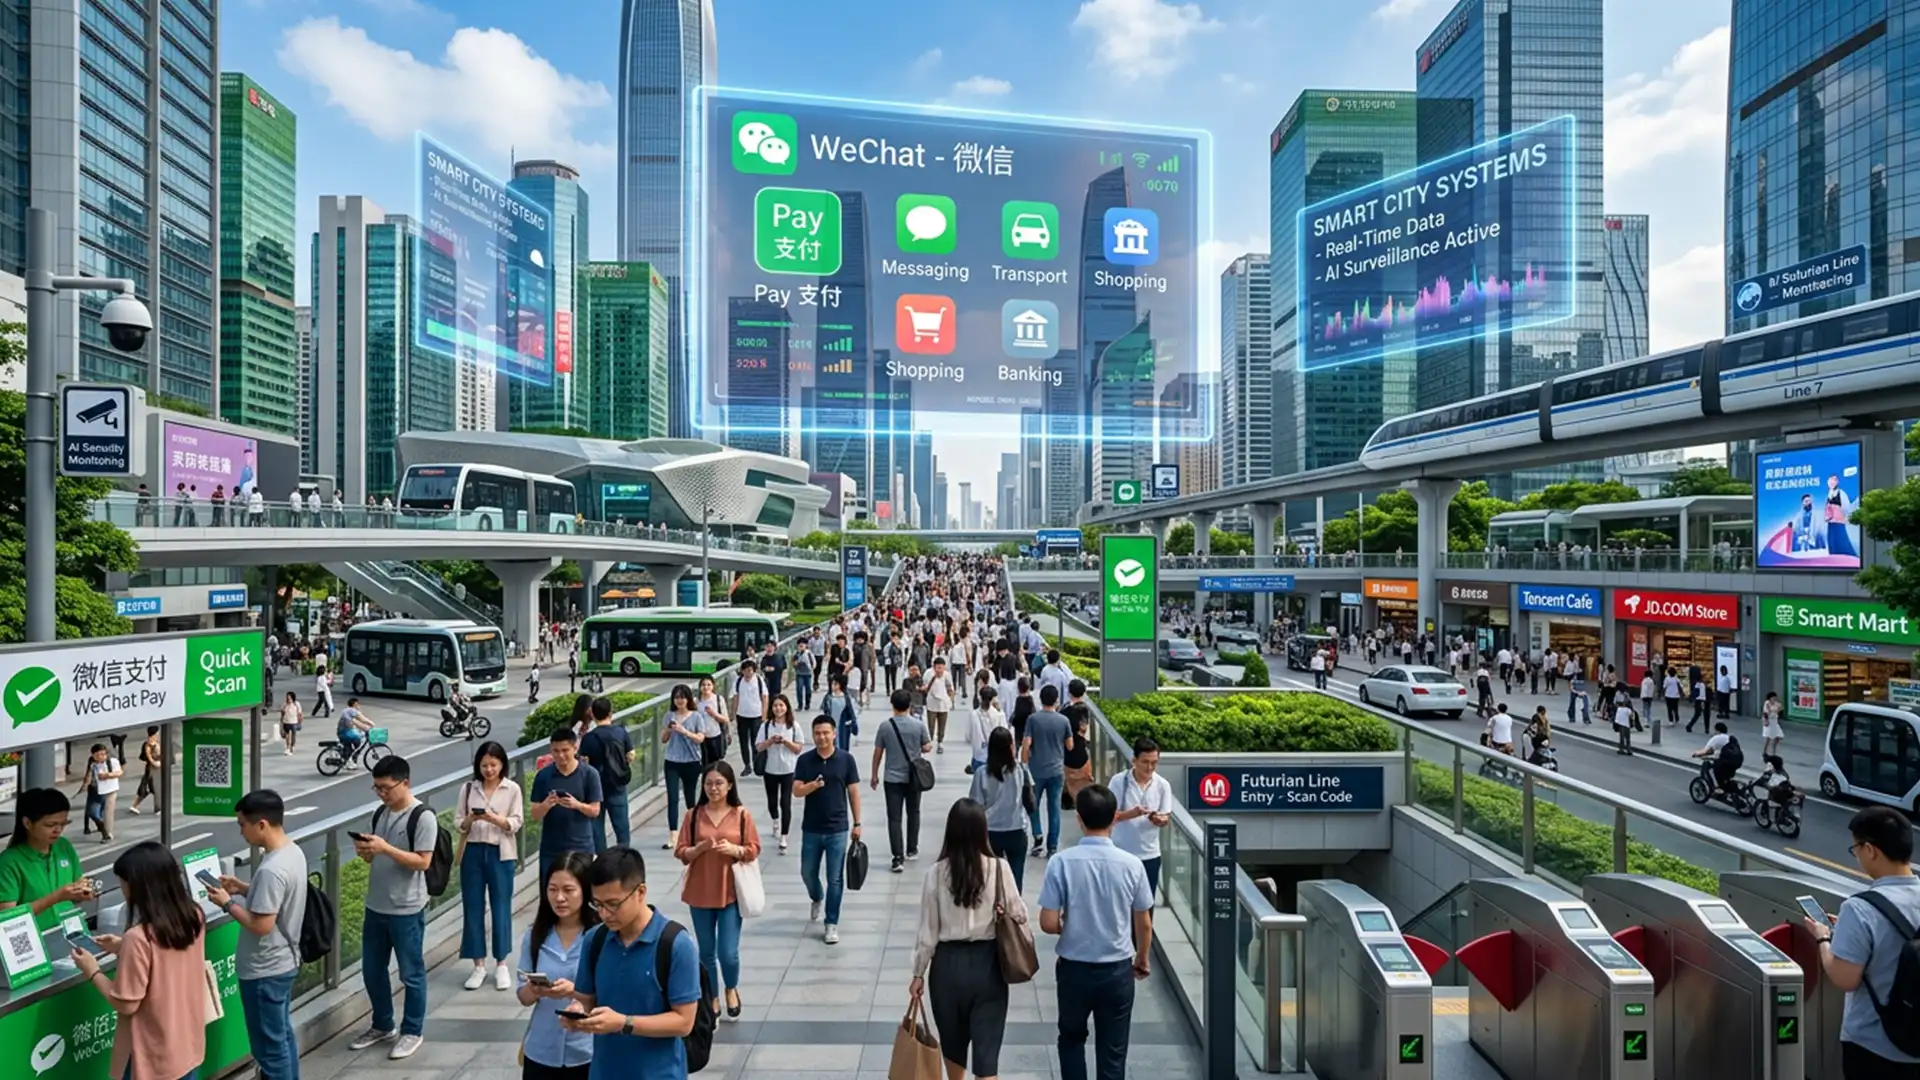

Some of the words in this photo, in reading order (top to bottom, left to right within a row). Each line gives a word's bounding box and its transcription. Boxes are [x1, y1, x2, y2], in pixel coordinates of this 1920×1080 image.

[811, 133, 925, 169] WeChat
[953, 142, 1015, 178] 微信
[1314, 199, 1379, 237] SMART
[1383, 181, 1431, 214] CITY
[1436, 143, 1547, 199] SYSTEMS
[773, 203, 824, 236] Pay
[1325, 226, 1402, 259] Real-Time
[1407, 211, 1446, 236] Data
[773, 237, 822, 262] 支付
[1325, 263, 1340, 282] AI
[1444, 221, 1501, 250] Active
[882, 259, 970, 282] Messaging
[992, 265, 1068, 286] Transport
[1094, 270, 1168, 294] Shopping
[754, 285, 791, 308] Pay
[798, 284, 842, 308] 支付
[886, 361, 965, 383] Shopping
[998, 365, 1063, 386] Banking
[1814, 382, 1824, 394] 7
[1522, 591, 1564, 608] Tencent
[1643, 600, 1693, 617] JD.COM
[1696, 605, 1728, 620] Store
[1798, 608, 1854, 630] Smart
[1859, 613, 1909, 634] Mart
[200, 647, 251, 673] Quick
[72, 655, 168, 692] 微信支付
[204, 675, 247, 696] Scan
[73, 690, 137, 716] WeChat
[140, 688, 167, 708] Pay
[1241, 773, 1305, 788] Futurian
[1309, 773, 1341, 788] Line
[1287, 790, 1317, 803] Scan
[1320, 791, 1353, 803] Code
